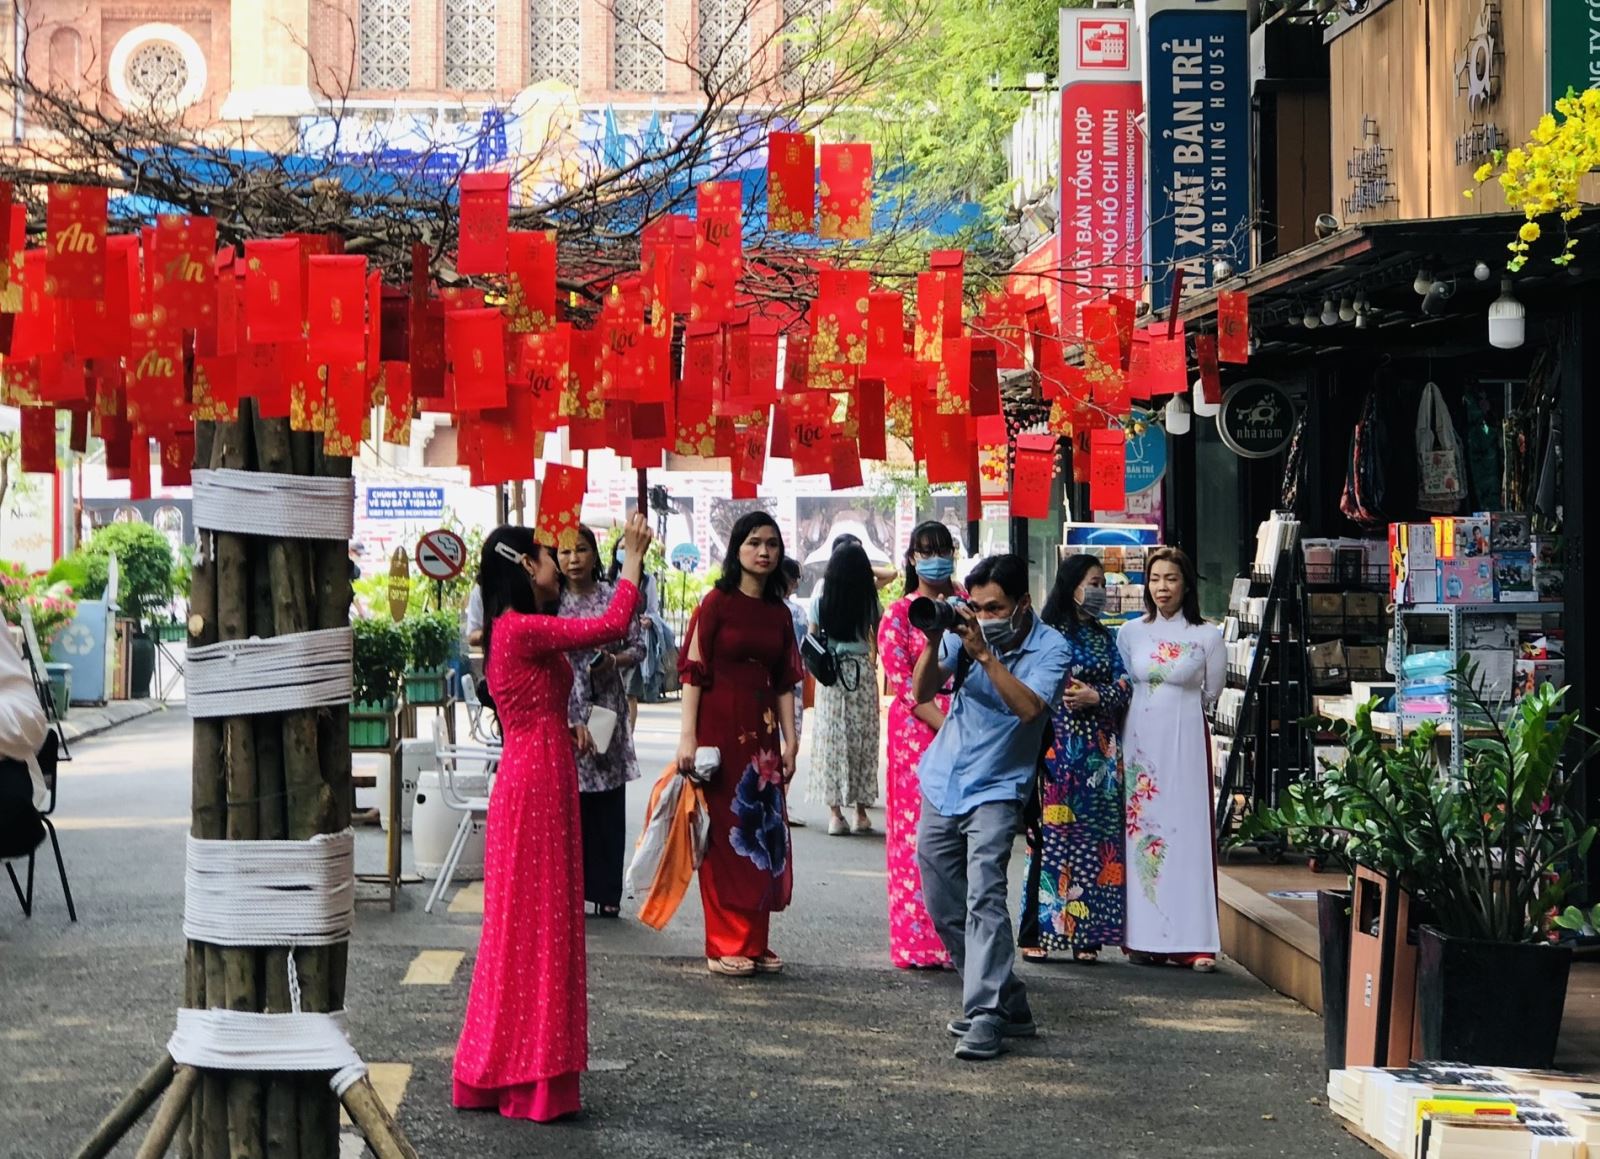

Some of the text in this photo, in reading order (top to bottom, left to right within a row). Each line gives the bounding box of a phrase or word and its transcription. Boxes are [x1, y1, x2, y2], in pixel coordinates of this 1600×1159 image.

[1161, 38, 1203, 94] TRẺ
[1209, 35, 1225, 107] HOUSE
[1074, 107, 1095, 144] HỢP
[1103, 110, 1119, 156] MINH
[1126, 109, 1135, 143] HOUSE
[1163, 101, 1204, 164] BẢN
[1068, 150, 1092, 200] TỔNG
[1099, 161, 1119, 193] CHÍ
[1126, 144, 1135, 204] PUBLISHING
[1070, 205, 1092, 242] BẢN
[1096, 197, 1119, 224] HỒ
[1126, 205, 1135, 249] GENERAL
[1163, 171, 1206, 247] XUẤT
[56, 222, 98, 254] An
[166, 253, 205, 283] An
[1069, 247, 1092, 295] XUẤT
[1126, 250, 1135, 273] CITY
[610, 327, 638, 356] Lộc
[136, 349, 175, 380] An
[526, 368, 555, 398] Lộc
[795, 422, 823, 449] Lộc
